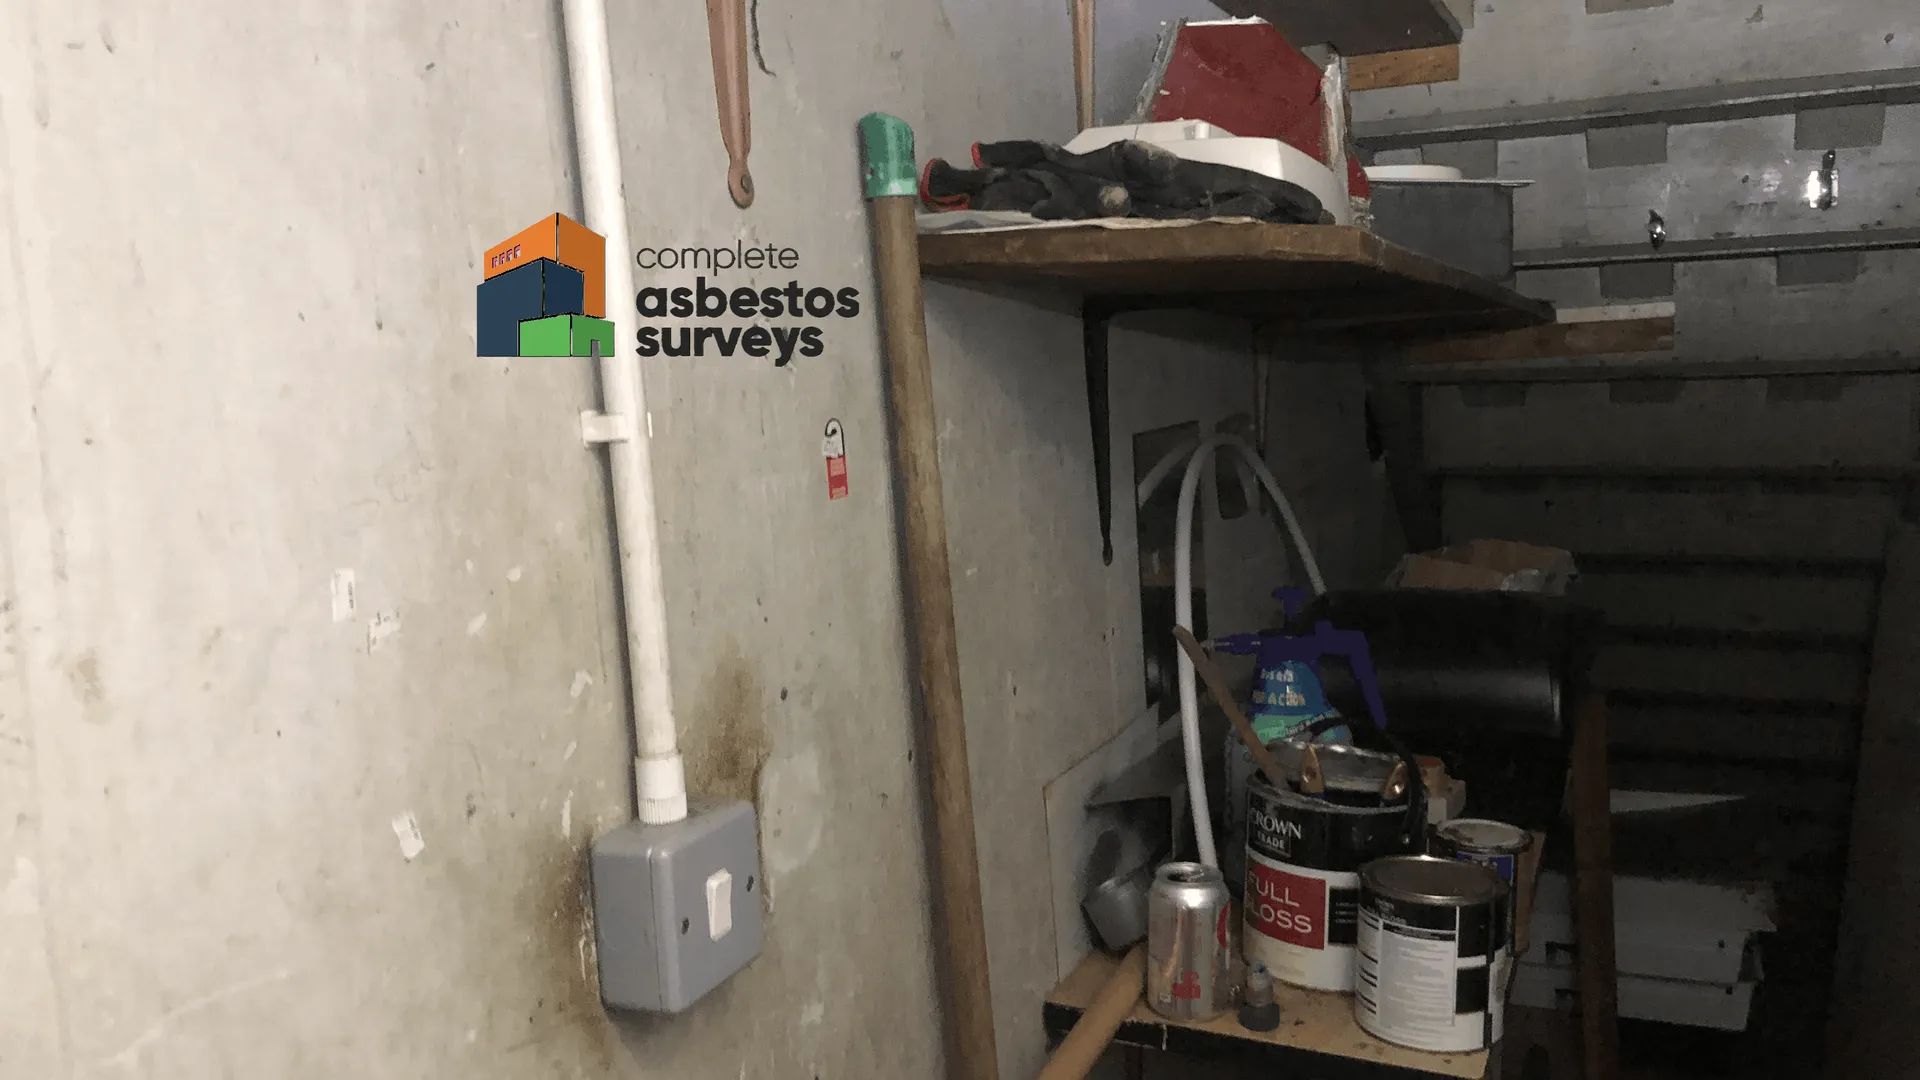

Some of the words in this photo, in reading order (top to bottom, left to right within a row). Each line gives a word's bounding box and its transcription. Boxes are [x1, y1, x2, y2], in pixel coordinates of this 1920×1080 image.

[1250, 807, 1302, 840] CROWN
[1257, 830, 1285, 849] TRADE
[1248, 895, 1313, 934] LOSS
